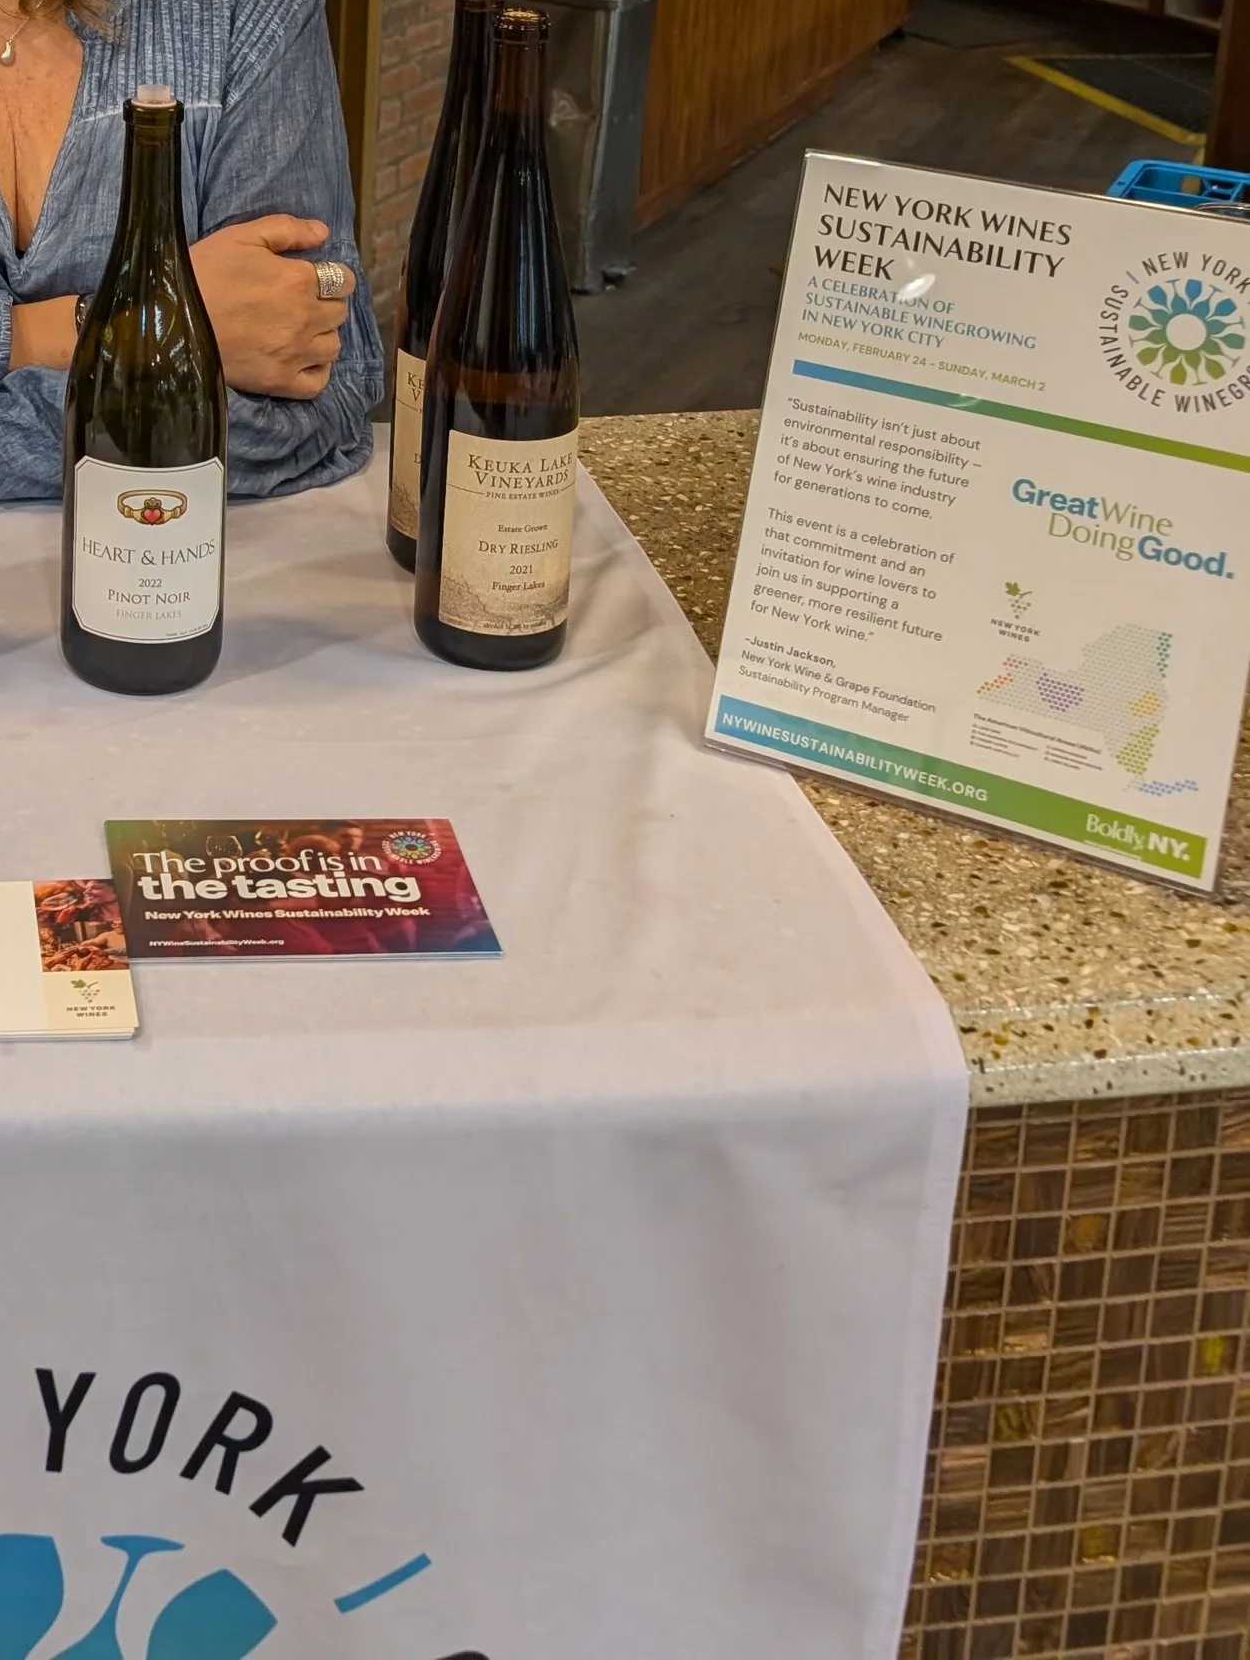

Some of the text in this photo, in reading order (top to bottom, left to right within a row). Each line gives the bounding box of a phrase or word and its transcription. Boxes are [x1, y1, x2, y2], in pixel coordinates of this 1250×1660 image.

[823, 181, 1071, 245] NEW YORK WINES
[817, 214, 1064, 277] SUSTAINABILITY
[814, 245, 894, 280] WEEK
[1141, 251, 1250, 295] NEW YORK
[806, 275, 955, 315] A CELEBRATON OF
[801, 306, 944, 348] IN NEW YORK CITY
[805, 292, 1035, 348] SUSTAINABLE WINEGROWING
[797, 331, 849, 351] MONDAY,
[852, 342, 910, 362] FEBRUARY
[912, 355, 926, 365] 24
[937, 360, 987, 380] SUNDAY,
[991, 371, 1035, 388] MARCH
[1037, 381, 1045, 391] 2
[1099, 284, 1166, 407] SUSTAINABLE
[467, 452, 573, 474] KEUKA LAKE
[474, 469, 569, 489] VINEYARDS
[486, 489, 559, 500] FINE ESTATE WINES
[498, 524, 548, 533] Estate Grown
[768, 507, 955, 563] This event is a celebration of
[82, 537, 215, 565] HEART & HANDS
[478, 540, 558, 555] DRY RIESLING
[764, 525, 925, 576] that commitment and an
[138, 579, 162, 588] 2022
[509, 564, 534, 575] 2021
[760, 544, 936, 599] invitation for wine lovers to
[108, 589, 191, 605] PINOT NOIR
[492, 581, 545, 593] Finger Lakes
[116, 609, 182, 620] FINGER LAKES
[722, 713, 987, 804] NYWINESUSTAINABILITYWEEK.ORG
[1146, 828, 1190, 861] NY.
[133, 848, 383, 879] The proof is in
[137, 871, 422, 903] the tasting
[145, 906, 431, 921] New York Wines Sustainability Week
[35, 1366, 364, 1548] YORK
